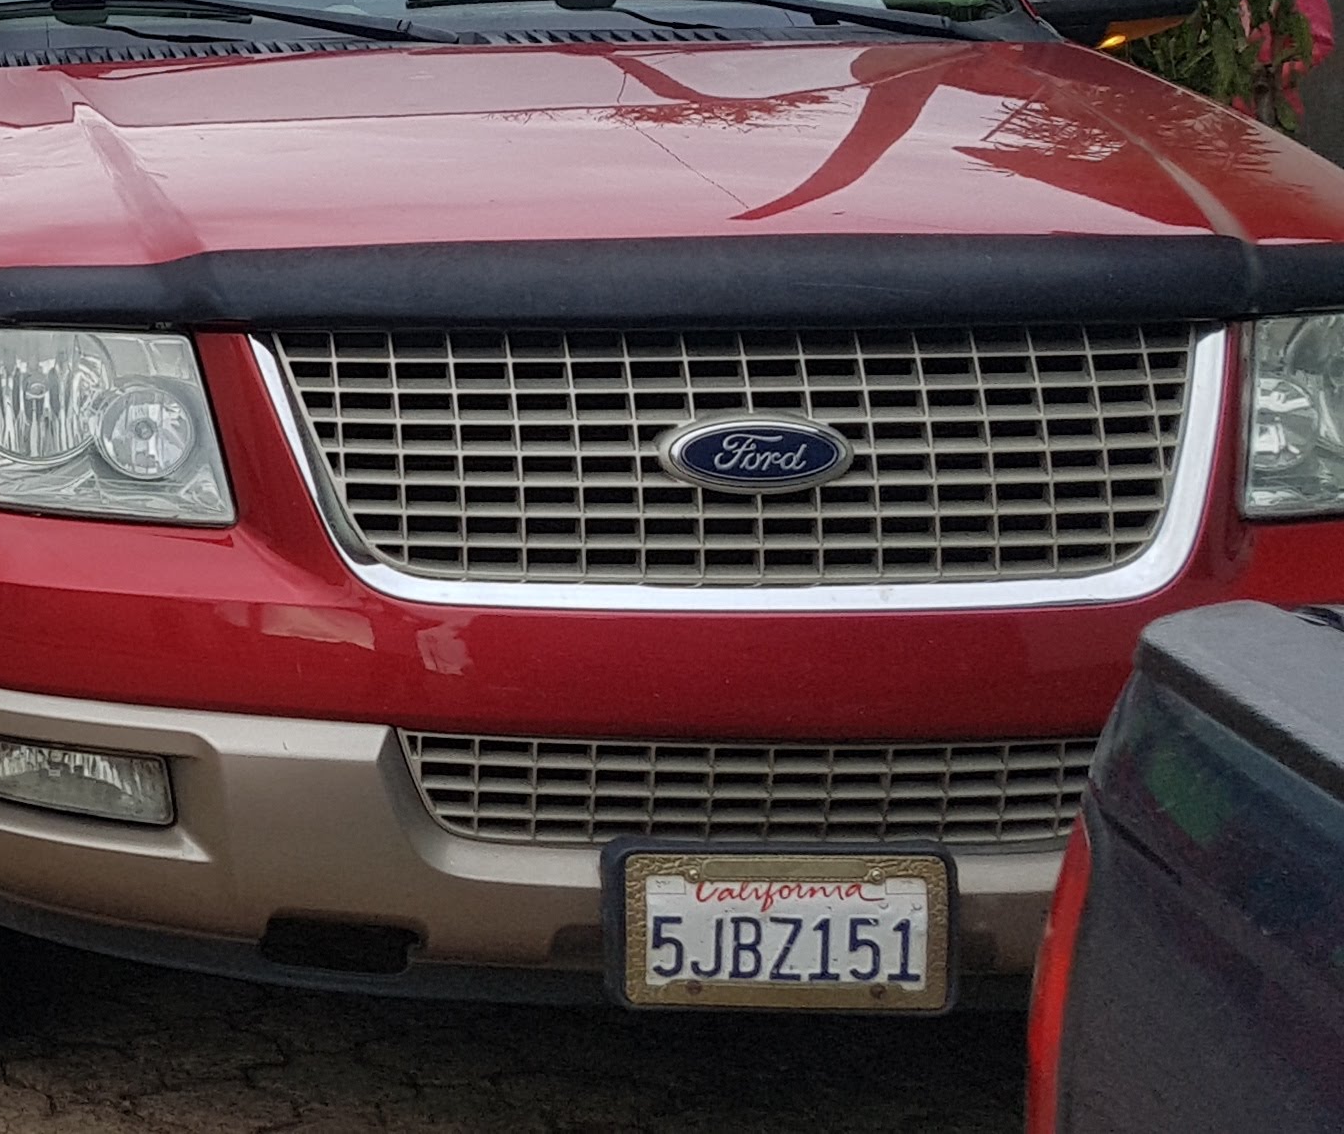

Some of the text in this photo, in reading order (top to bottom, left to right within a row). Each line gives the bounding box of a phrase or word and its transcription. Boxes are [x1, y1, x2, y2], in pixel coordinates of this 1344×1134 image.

[714, 433, 807, 471] Ford
[695, 880, 885, 912] California
[651, 915, 921, 982] 5JBZ151
